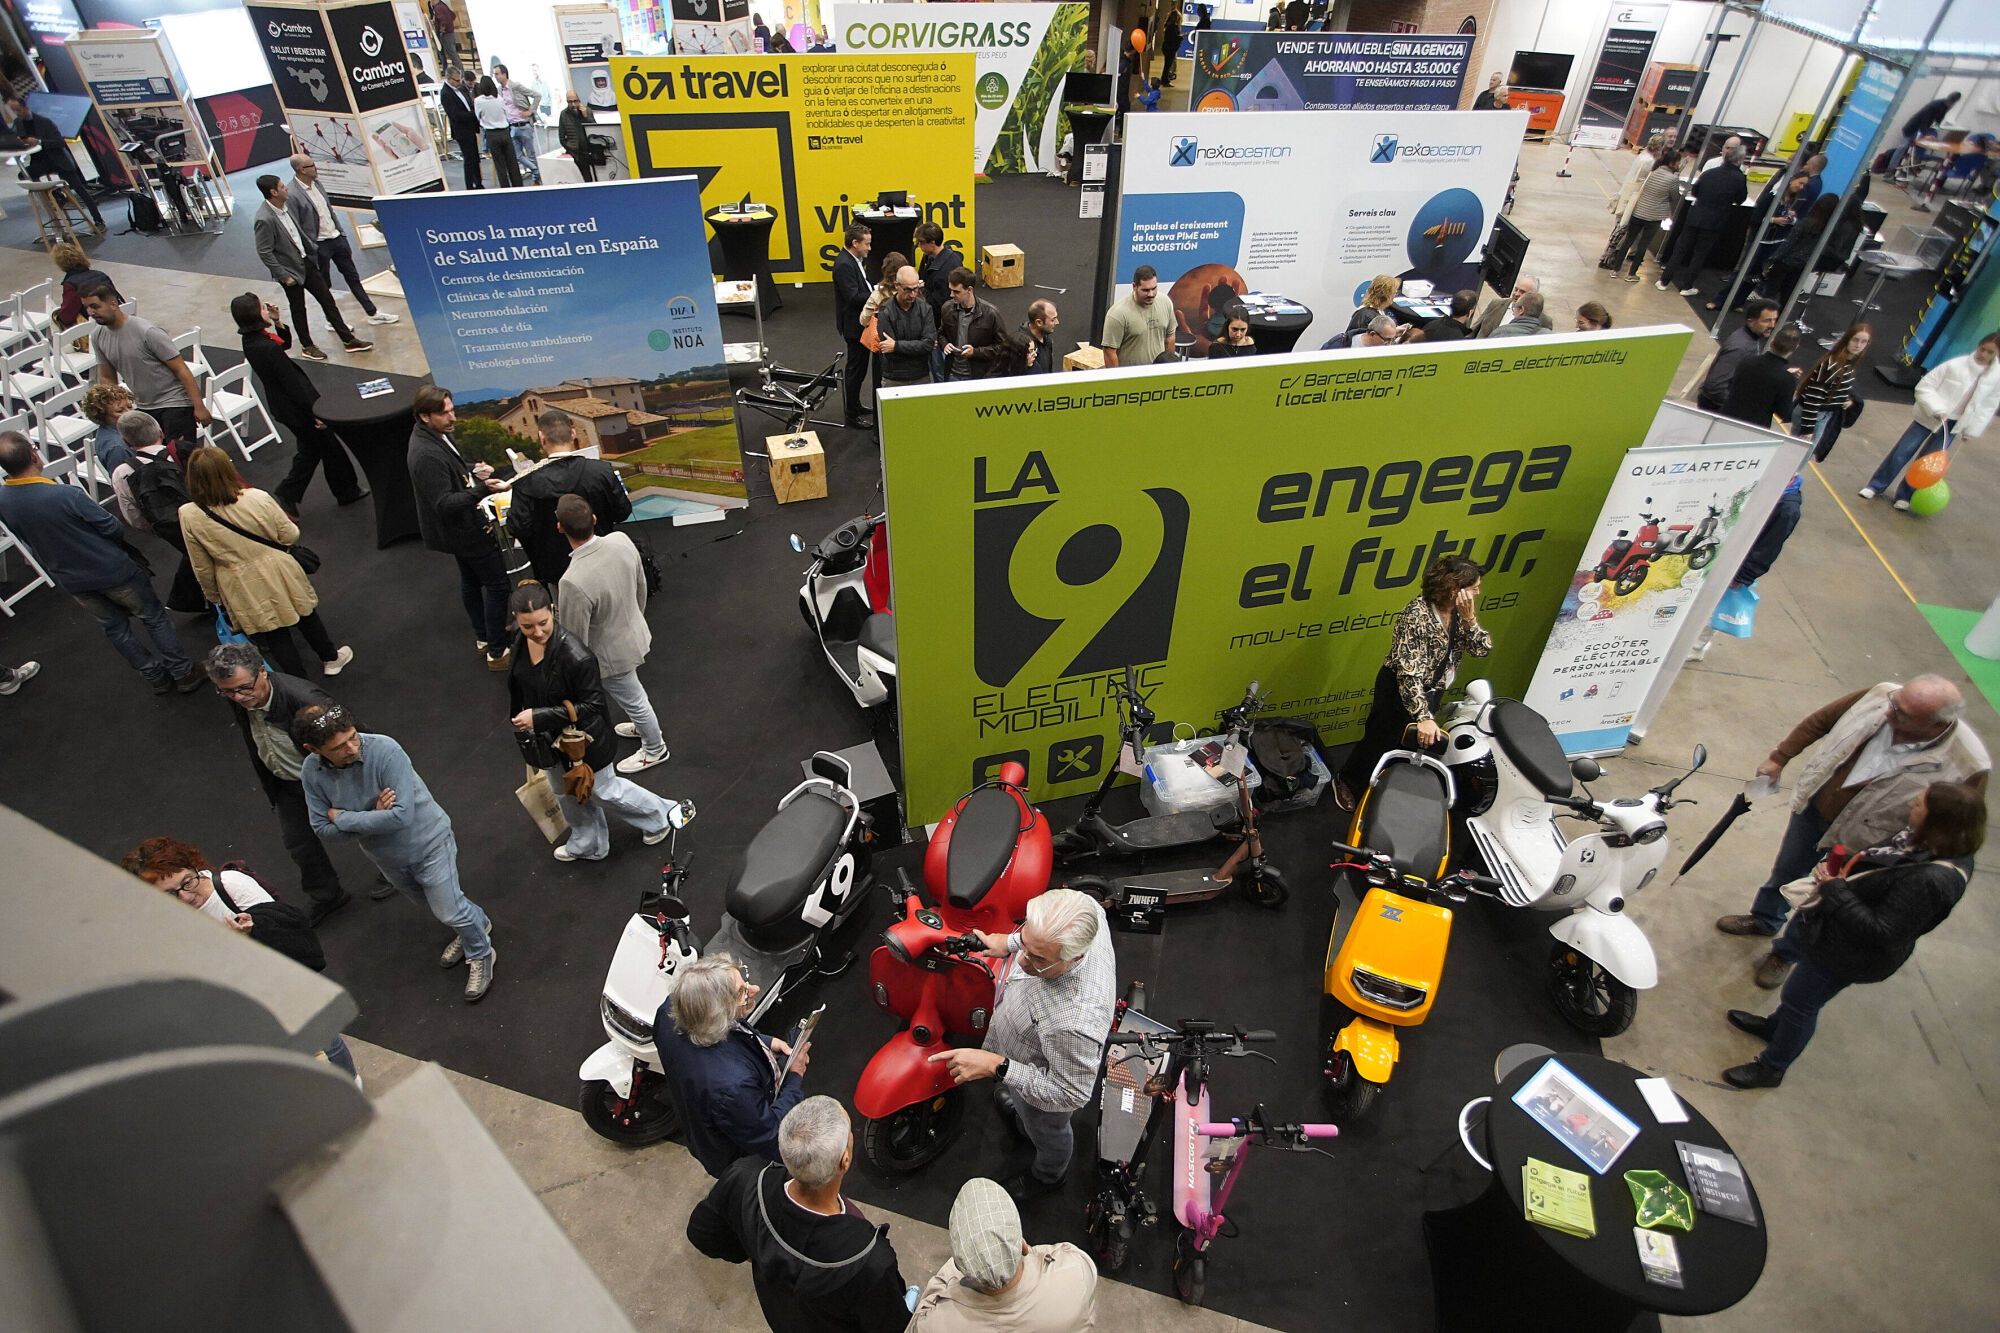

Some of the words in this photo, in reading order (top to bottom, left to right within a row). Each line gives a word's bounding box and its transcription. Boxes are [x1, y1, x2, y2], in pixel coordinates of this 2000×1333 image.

[281, 23, 313, 34] Cambra
[845, 21, 1032, 49] CORVIGRASS
[270, 45, 290, 54] SALUT
[294, 47, 327, 57] BENESTAR
[1276, 41, 1315, 54] VENDE
[1317, 42, 1334, 54] TU
[1334, 42, 1390, 55] INMUEBLE
[1391, 43, 1412, 55] SIN
[1412, 44, 1464, 56] AGENCIA
[353, 60, 406, 83] Cambra
[802, 63, 836, 74] explorar
[856, 63, 880, 72] ciutat
[881, 61, 939, 74] desconeguda
[940, 61, 946, 71] ó
[1304, 61, 1374, 74] AHORRANDO
[1374, 61, 1412, 74] HASTA
[1413, 62, 1451, 75] 35.000
[1452, 63, 1460, 74] €
[680, 64, 789, 100] travel
[803, 74, 843, 84] descobrir
[844, 75, 873, 83] racons
[875, 76, 891, 85] que
[893, 75, 904, 83] no
[905, 74, 931, 83] surten
[940, 74, 956, 84] cap
[1355, 78, 1365, 87] TE
[1364, 77, 1409, 88] ENSEÑAMOS
[1409, 79, 1429, 88] PASO
[1429, 80, 1435, 88] A
[1436, 80, 1456, 88] PASO
[361, 84, 368, 92] de
[804, 87, 822, 97] guia
[823, 86, 830, 95] ó
[831, 86, 856, 97] viatjar
[858, 85, 869, 95] de
[870, 85, 901, 94] l'oficina
[909, 84, 961, 94] destinacions
[804, 98, 816, 107] on
[817, 97, 825, 106] la
[826, 97, 847, 106] feina
[859, 96, 903, 105] converteix
[916, 96, 933, 104] una
[1304, 102, 1338, 110] Contamos
[1352, 102, 1376, 111] aliados
[1376, 103, 1405, 112] expertos
[1414, 103, 1431, 111] cada
[1431, 103, 1450, 112] etapa
[805, 108, 842, 118] aventura
[843, 107, 850, 117] ó
[851, 107, 891, 119] despertar
[892, 108, 902, 116] en
[904, 106, 953, 118] allotjaments
[806, 118, 855, 129] inoblidables
[856, 120, 873, 130] que
[874, 118, 917, 129] desperten
[917, 117, 924, 126] la
[926, 117, 966, 126] creativitat
[836, 134, 863, 145] travel
[1348, 209, 1378, 217] Serveis
[1378, 209, 1396, 217] clau
[426, 226, 487, 244] Somos
[490, 224, 506, 240] la
[509, 223, 565, 243] mayor
[568, 217, 598, 233] red
[1133, 221, 1169, 233] Impulsa
[1170, 221, 1178, 230] el
[1179, 220, 1228, 230] creixement
[1132, 232, 1143, 242] de
[1145, 232, 1155, 242] la
[1155, 233, 1175, 241] teva
[1176, 232, 1199, 241] PIME
[1200, 230, 1220, 240] amb
[434, 250, 456, 267] de
[458, 244, 508, 265] Salud
[511, 241, 572, 261] Mental
[575, 241, 596, 255] en
[598, 234, 659, 255] España
[1131, 241, 1198, 252] NEXOGESTIÓN
[441, 272, 485, 286] Centros
[486, 270, 500, 283] de
[502, 264, 584, 282] desintoxicación
[447, 290, 490, 304] Clínicas
[491, 287, 505, 299] de
[506, 285, 535, 299] salud
[536, 283, 574, 296] mental
[451, 302, 548, 321] Neuromodulación
[457, 323, 499, 338] Centros
[500, 322, 514, 334] de
[515, 320, 533, 333] día
[672, 326, 703, 335] INSTITUTO
[463, 339, 528, 355] Tratamiento
[530, 333, 593, 350] ambulatorio
[673, 334, 705, 350] NOA
[468, 355, 520, 371] Psicología
[521, 352, 555, 366] online
[1464, 348, 1628, 375] @la9_electricmobility
[1280, 372, 1301, 390] c/
[1303, 366, 1393, 389] Barcelona
[975, 382, 1234, 418] www.la9urbansports.com
[1284, 389, 1327, 407] local
[1331, 385, 1394, 403] interior
[1631, 459, 1761, 476] QUAZZARTECH
[973, 450, 1061, 503] LA
[1257, 444, 1572, 528] engega
[1238, 544, 1315, 609] el
[1338, 528, 1546, 596] futur,
[1229, 619, 1322, 650] mou-te
[1479, 591, 1520, 612] la9.
[1583, 639, 1649, 653] SCOOTER
[1573, 648, 1650, 663] ELÉCTRICO
[1552, 656, 1660, 675] PERSONALIZABLE
[973, 664, 1166, 718] ELECTRIC
[1280, 699, 1301, 710] en
[1303, 688, 1367, 705] mobilitat
[1697, 1169, 1716, 1179] MOVE
[1700, 1178, 1719, 1188] YOUR
[1703, 1187, 1741, 1202] INSTINCTS
